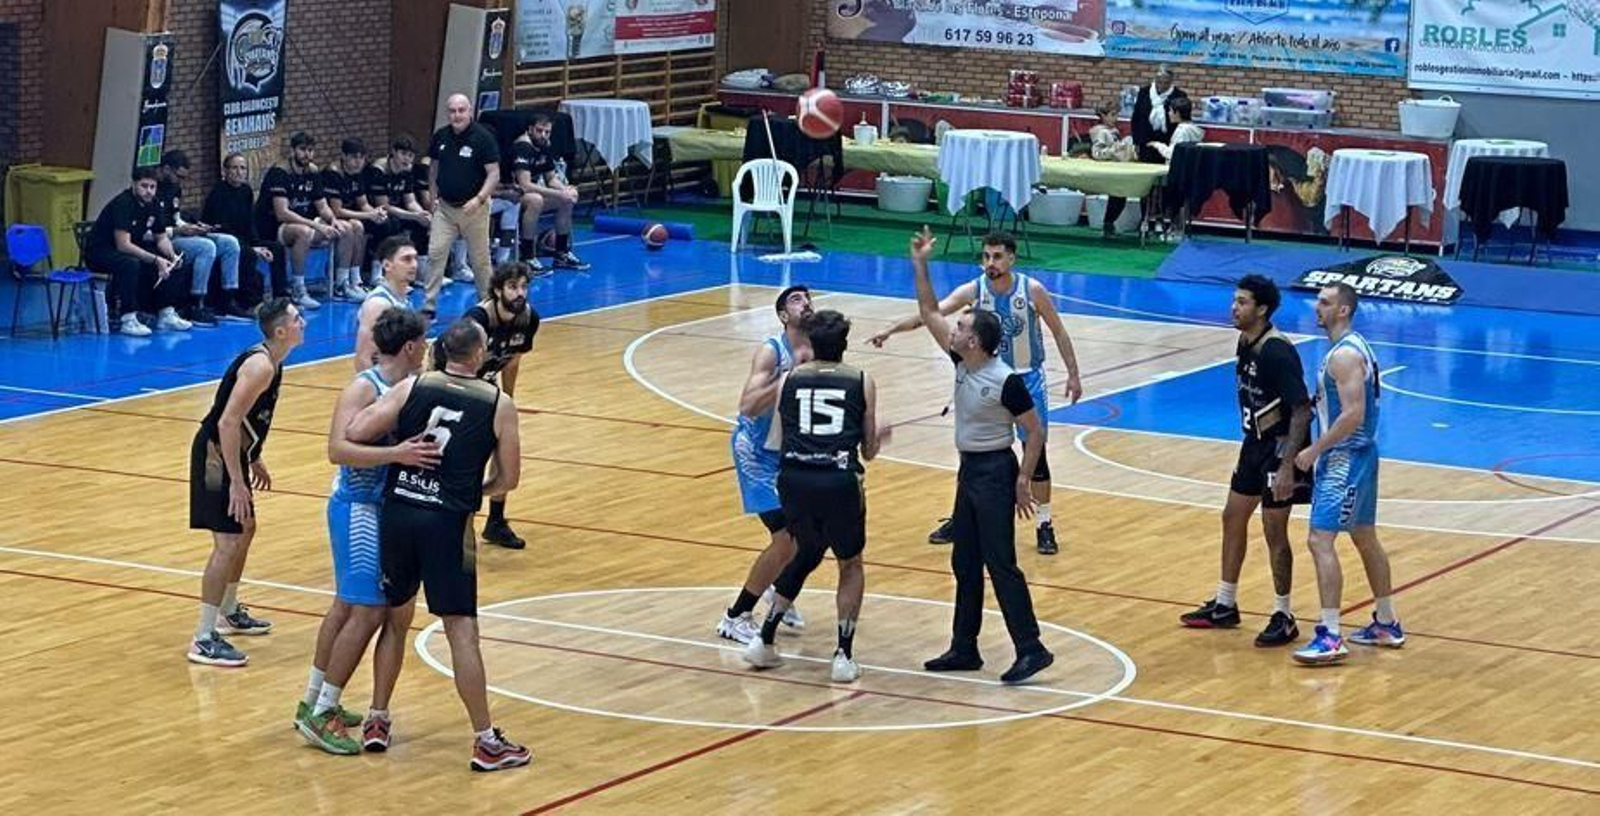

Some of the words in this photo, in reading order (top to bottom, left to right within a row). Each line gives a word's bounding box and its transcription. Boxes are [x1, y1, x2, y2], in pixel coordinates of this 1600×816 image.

[1014, 5, 1071, 20] Estepona
[945, 28, 970, 41] 617
[976, 29, 991, 42] 59
[996, 31, 1013, 44] 96
[1018, 32, 1034, 46] 23
[1211, 32, 1235, 50] year
[1247, 30, 1287, 47] Abierto
[1289, 33, 1310, 49] todo
[1423, 24, 1528, 48] ROBLES
[224, 101, 240, 115] CLUB
[1303, 270, 1457, 299] SPARTANS
[795, 389, 846, 435] 15
